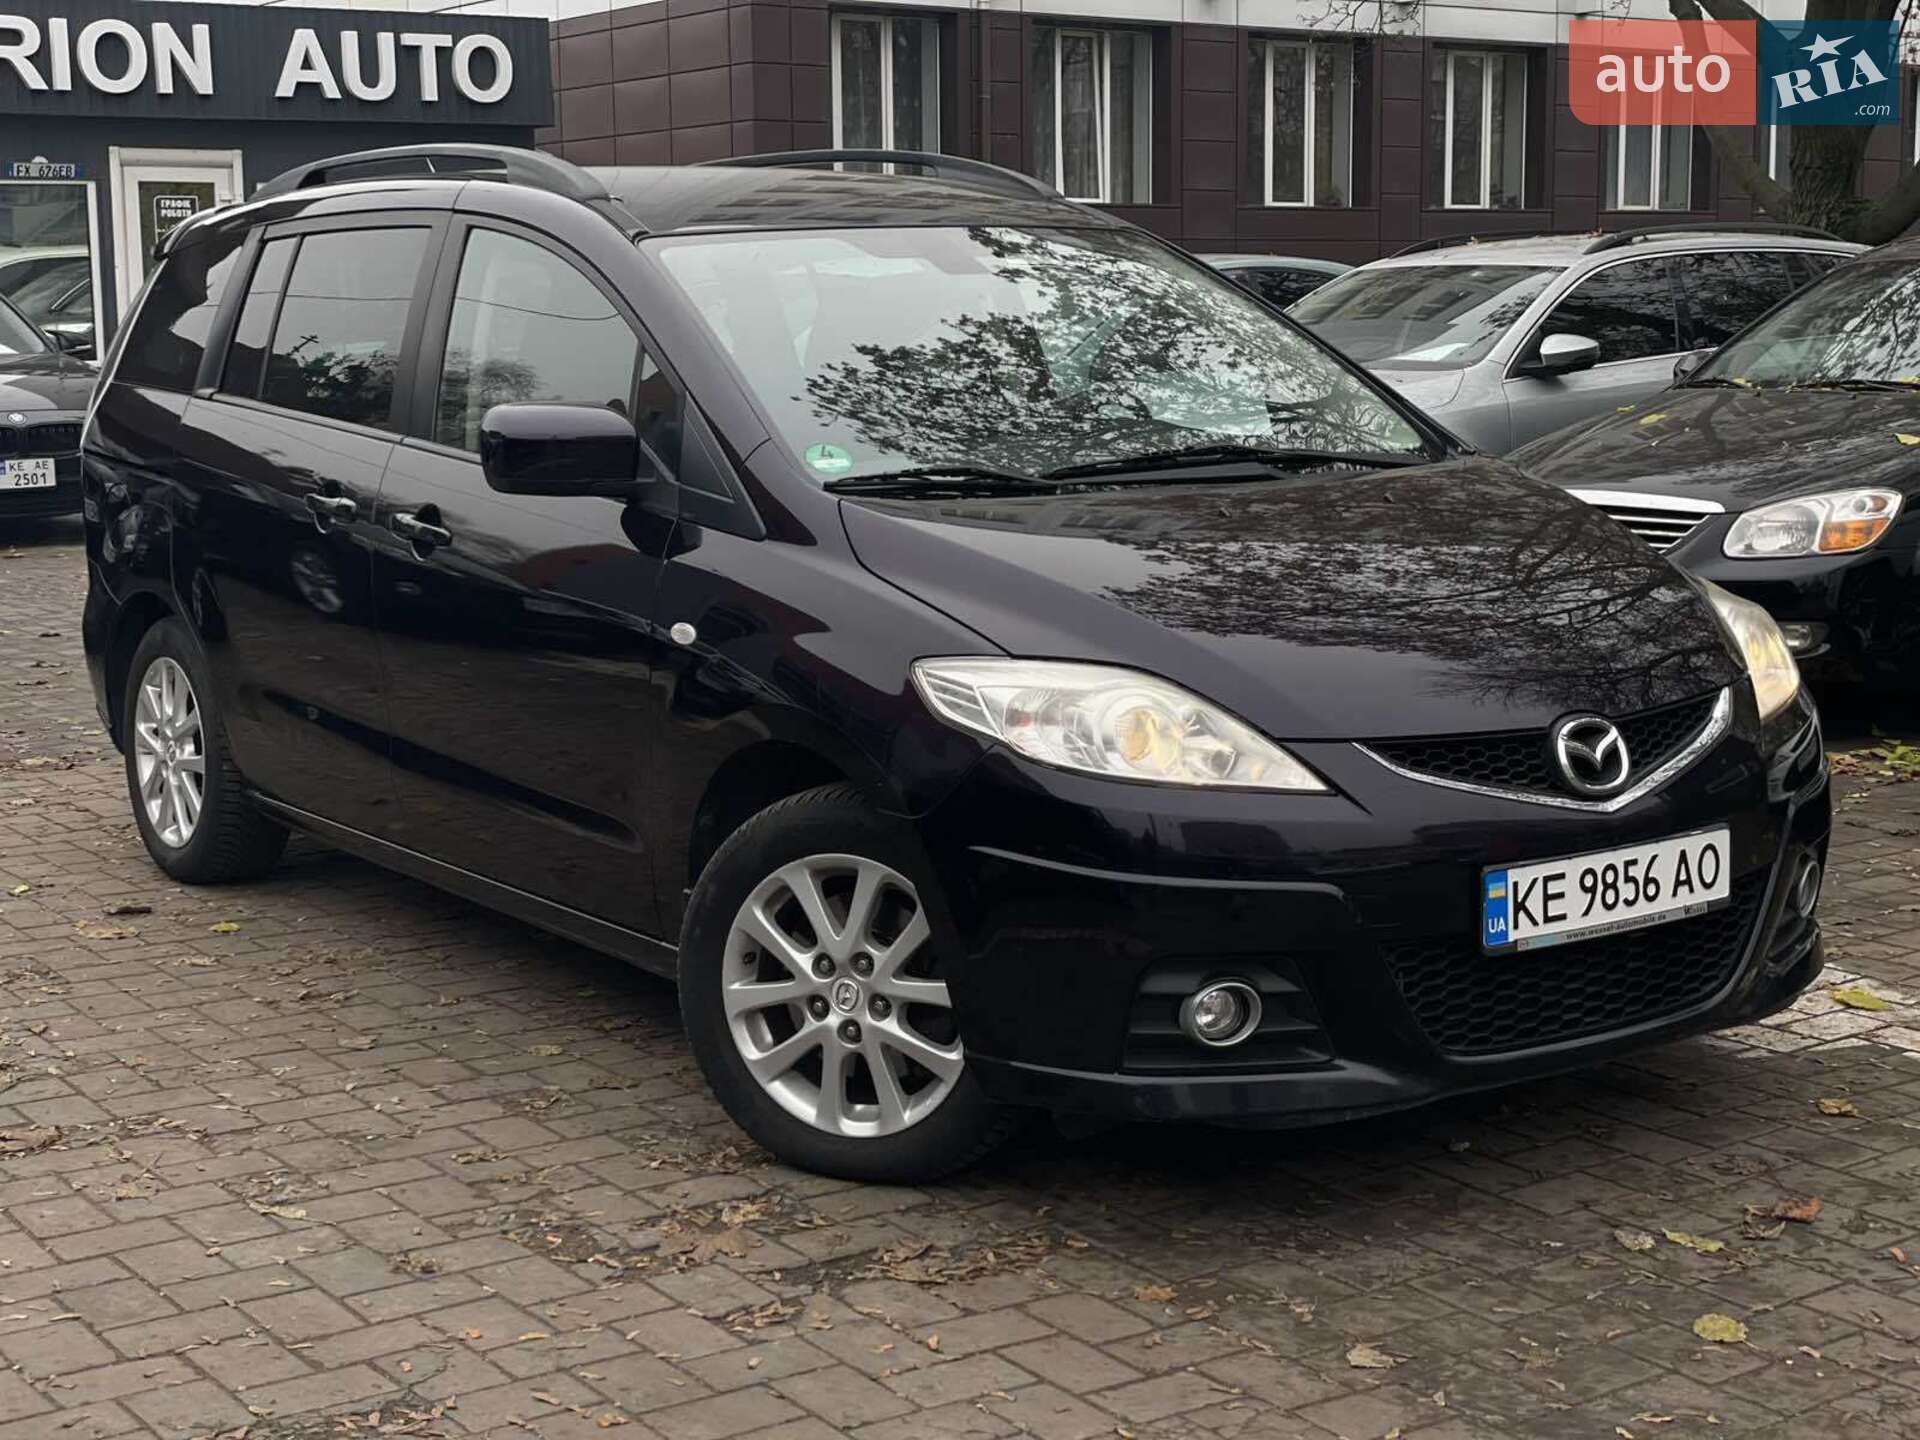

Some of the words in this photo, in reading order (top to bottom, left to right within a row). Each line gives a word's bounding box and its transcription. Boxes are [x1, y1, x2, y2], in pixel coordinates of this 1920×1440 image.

[0, 14, 214, 96] RION
[274, 28, 514, 104] AUTO
[9, 461, 25, 472] KE
[34, 460, 49, 470] AE
[14, 472, 47, 487] 2501
[1512, 872, 1568, 930] KE
[1579, 854, 1661, 918] 9856
[1672, 843, 1720, 898] AO
[1488, 917, 1506, 934] UA
